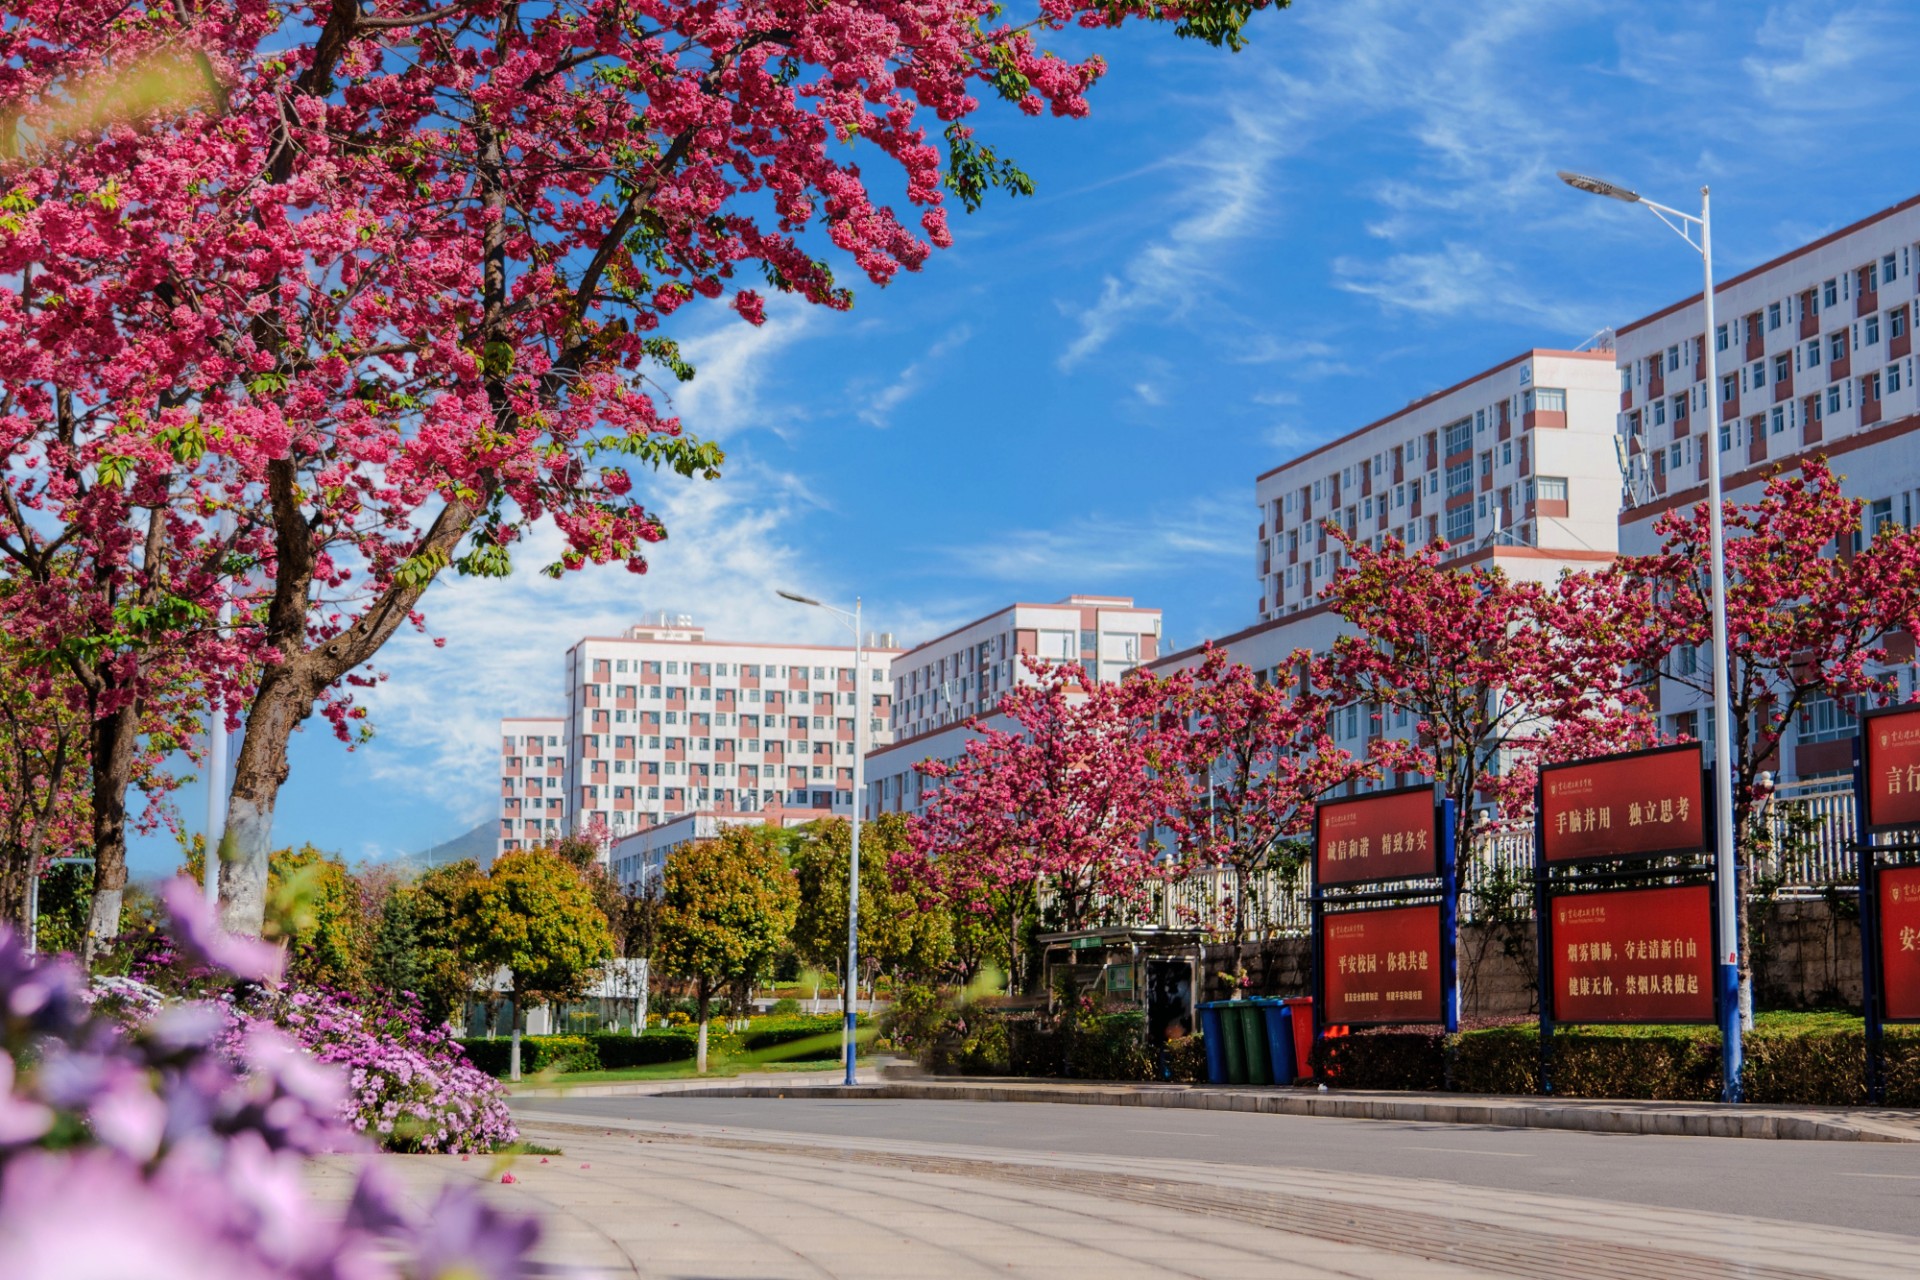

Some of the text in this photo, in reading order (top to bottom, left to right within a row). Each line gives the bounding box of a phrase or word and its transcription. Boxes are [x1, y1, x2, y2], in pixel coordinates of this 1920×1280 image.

[1885, 764, 1920, 794] 言行
[1555, 796, 1690, 835] 手脑并用 独立思考
[1327, 829, 1427, 861] 诚信和谐 精致务实
[1899, 925, 1920, 952] 安
